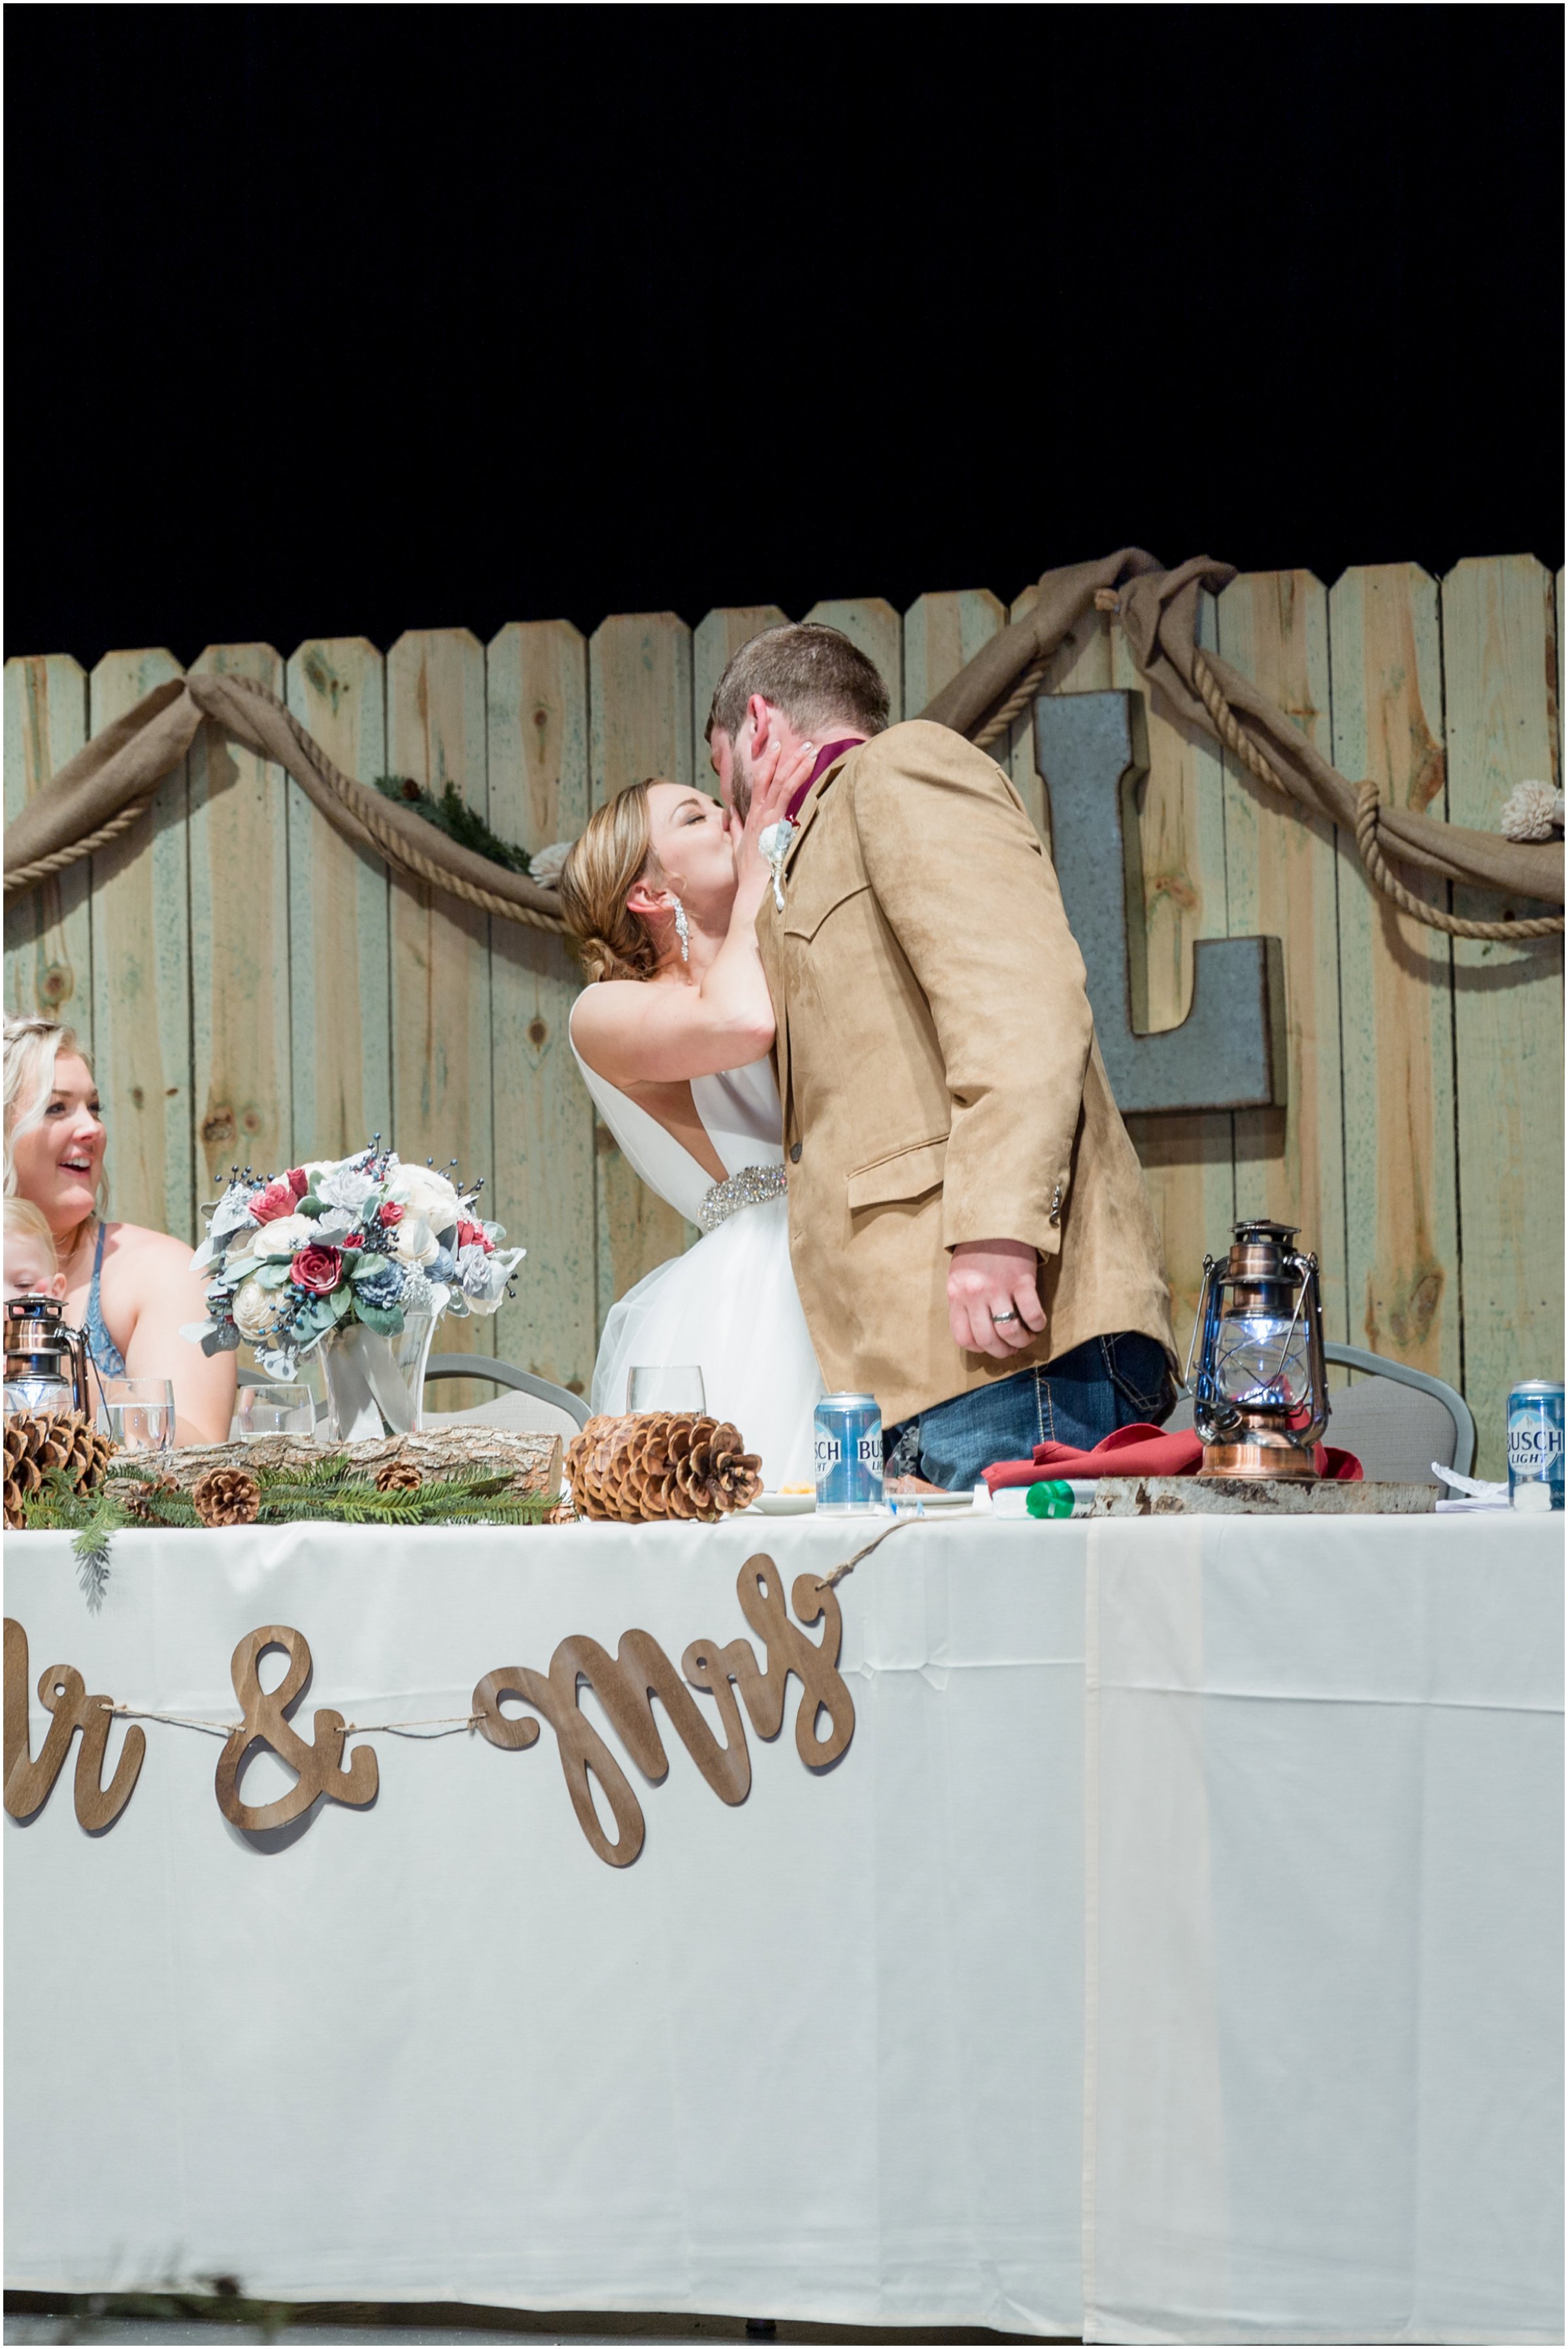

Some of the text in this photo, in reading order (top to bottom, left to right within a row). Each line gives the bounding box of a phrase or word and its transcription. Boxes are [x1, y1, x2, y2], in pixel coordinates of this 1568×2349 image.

[1033, 689, 1286, 1112] L
[1512, 1454, 1547, 1463] LIGHT
[215, 1625, 378, 1830] &
[472, 1553, 855, 1867] Mrs
